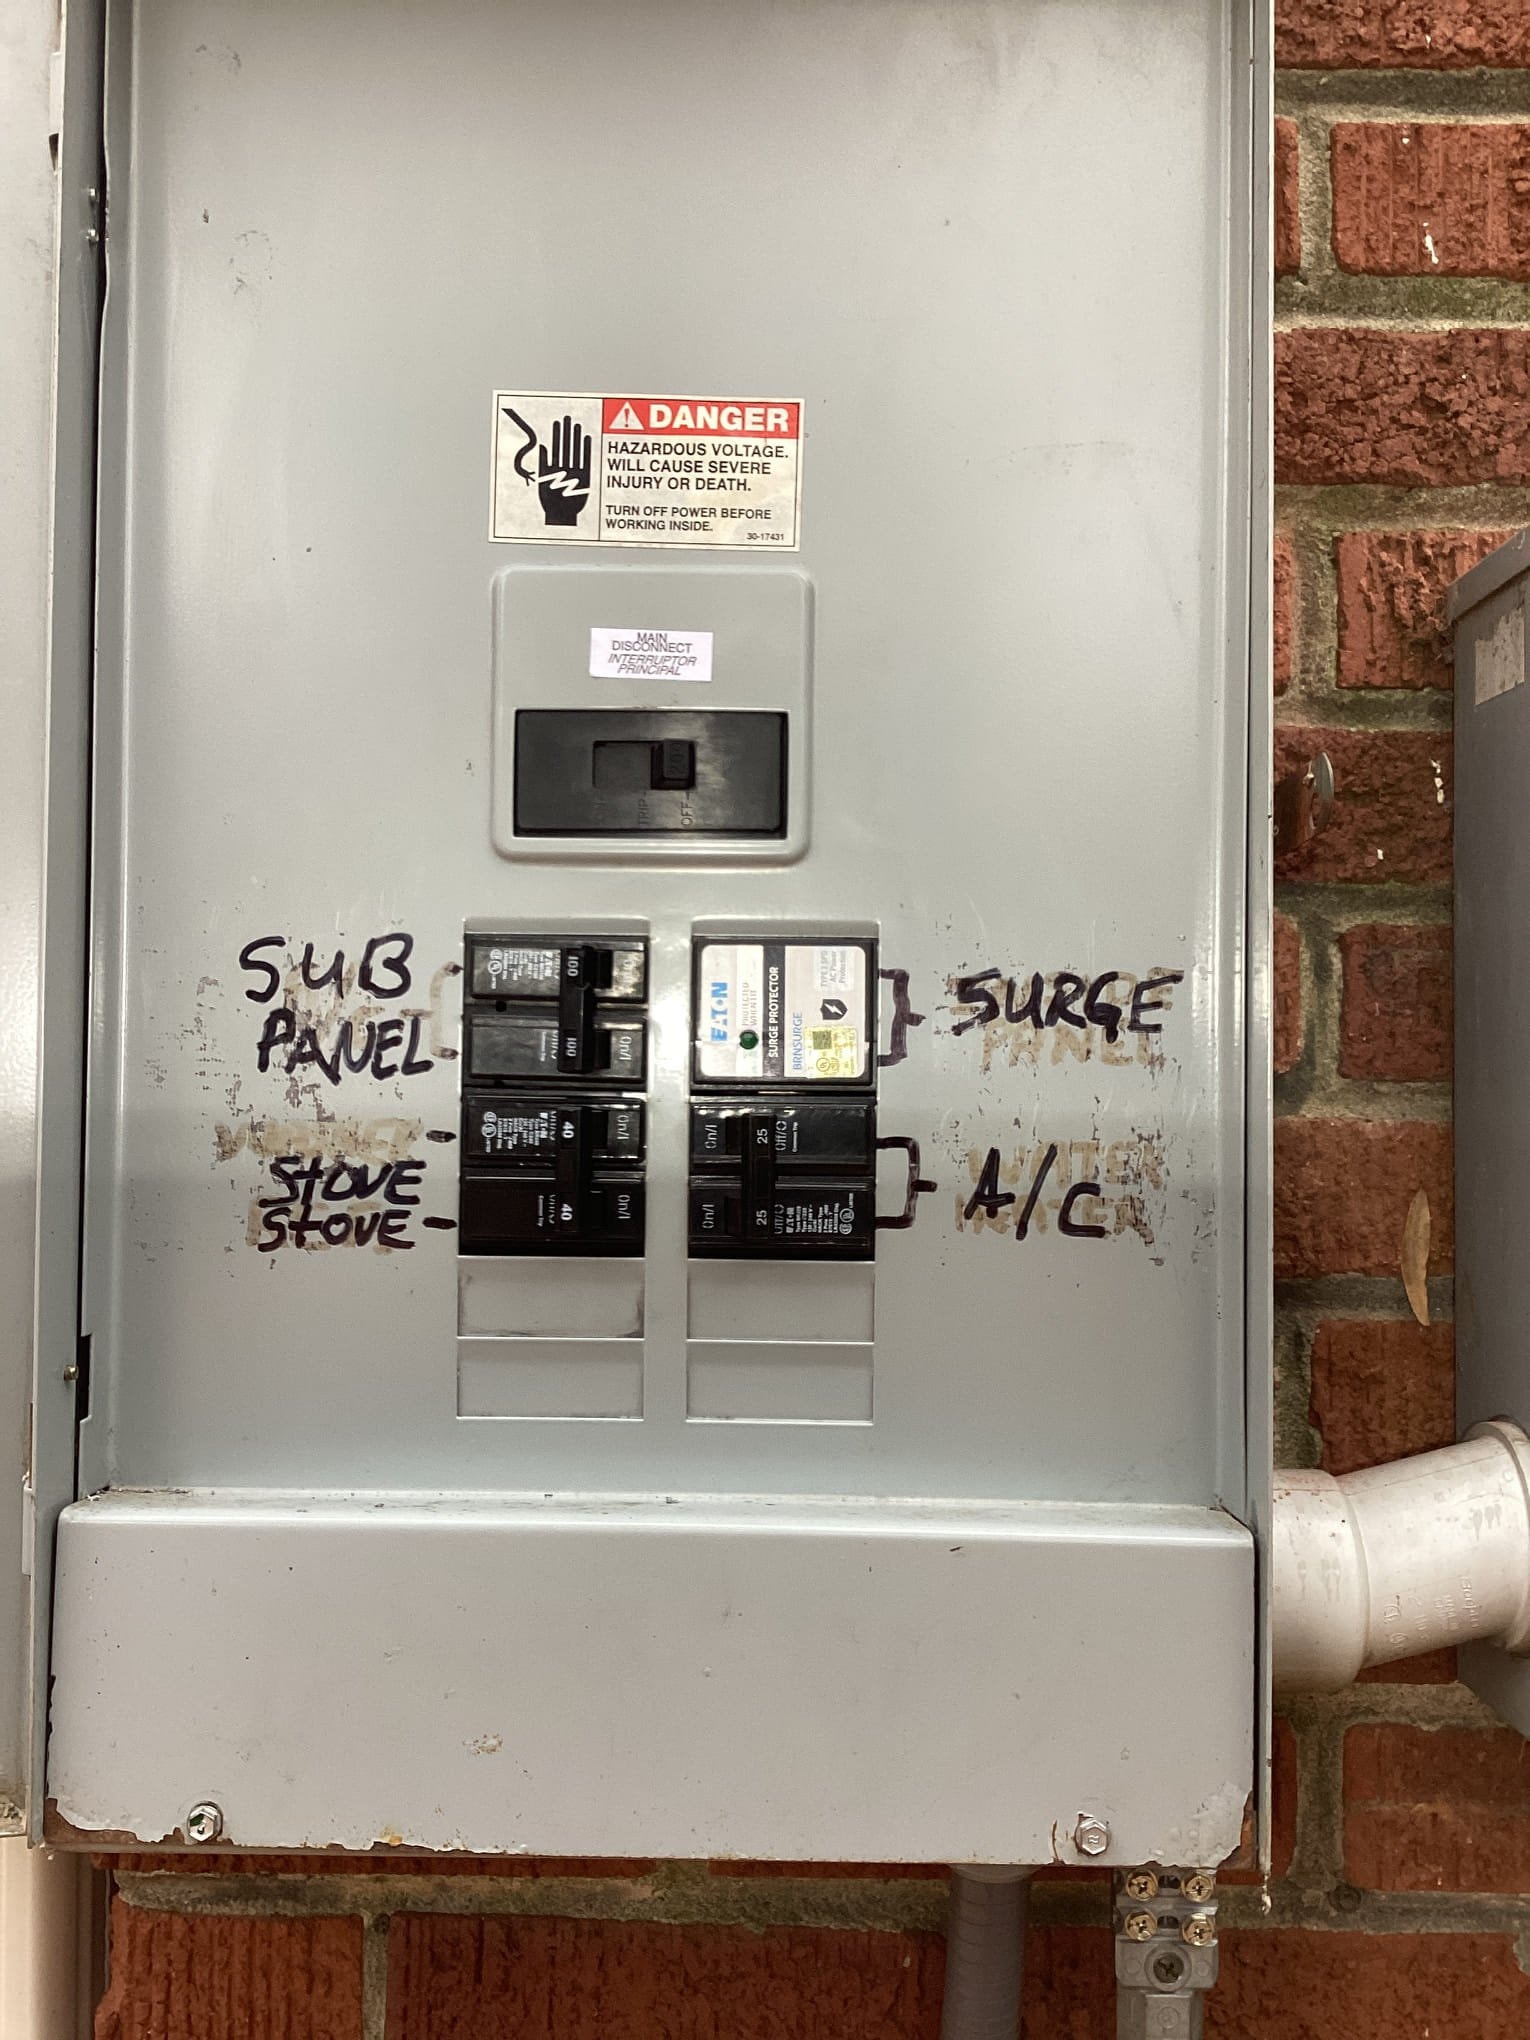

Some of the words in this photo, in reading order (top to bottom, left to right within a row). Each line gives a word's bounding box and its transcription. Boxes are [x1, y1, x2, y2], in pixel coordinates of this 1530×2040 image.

[650, 404, 789, 432] DANGER
[607, 441, 707, 456] HAZARDOUS
[711, 443, 789, 458] VOLTAGE.
[607, 458, 645, 472] WILL
[649, 460, 704, 473] CAUSE
[708, 461, 772, 475] SEVERE
[606, 476, 663, 490] INJURY
[667, 477, 690, 490] OR
[695, 478, 752, 491] DEATH.
[606, 505, 640, 516] TURN
[643, 506, 668, 516] OFF
[671, 507, 717, 518] POWER
[720, 508, 772, 520] BEFORE
[605, 519, 666, 530] WORKING
[669, 520, 713, 532] INSIDE.
[747, 533, 785, 541] 30-17431
[637, 632, 668, 642] MAIN
[612, 640, 693, 653] DISCONNECT
[608, 653, 698, 667] INTERRUPTOR
[617, 663, 682, 676] PRINCIPAL
[638, 799, 649, 826] TRIP
[681, 801, 693, 826] OFF
[239, 932, 414, 1003] SUB
[567, 956, 579, 977] 100
[768, 966, 779, 1022] PROTECTOR
[710, 982, 728, 1042] EATON
[952, 967, 1184, 1043] SURGE
[257, 1008, 434, 1086] PANEL
[565, 1037, 577, 1057] 100
[768, 1025, 779, 1058] SURGE
[792, 1012, 803, 1070] BRNSURGE
[562, 1121, 575, 1139] 40
[757, 1128, 768, 1144] 25
[964, 1143, 1106, 1241] A/C
[560, 1203, 573, 1221] 40
[756, 1209, 768, 1225] 25
